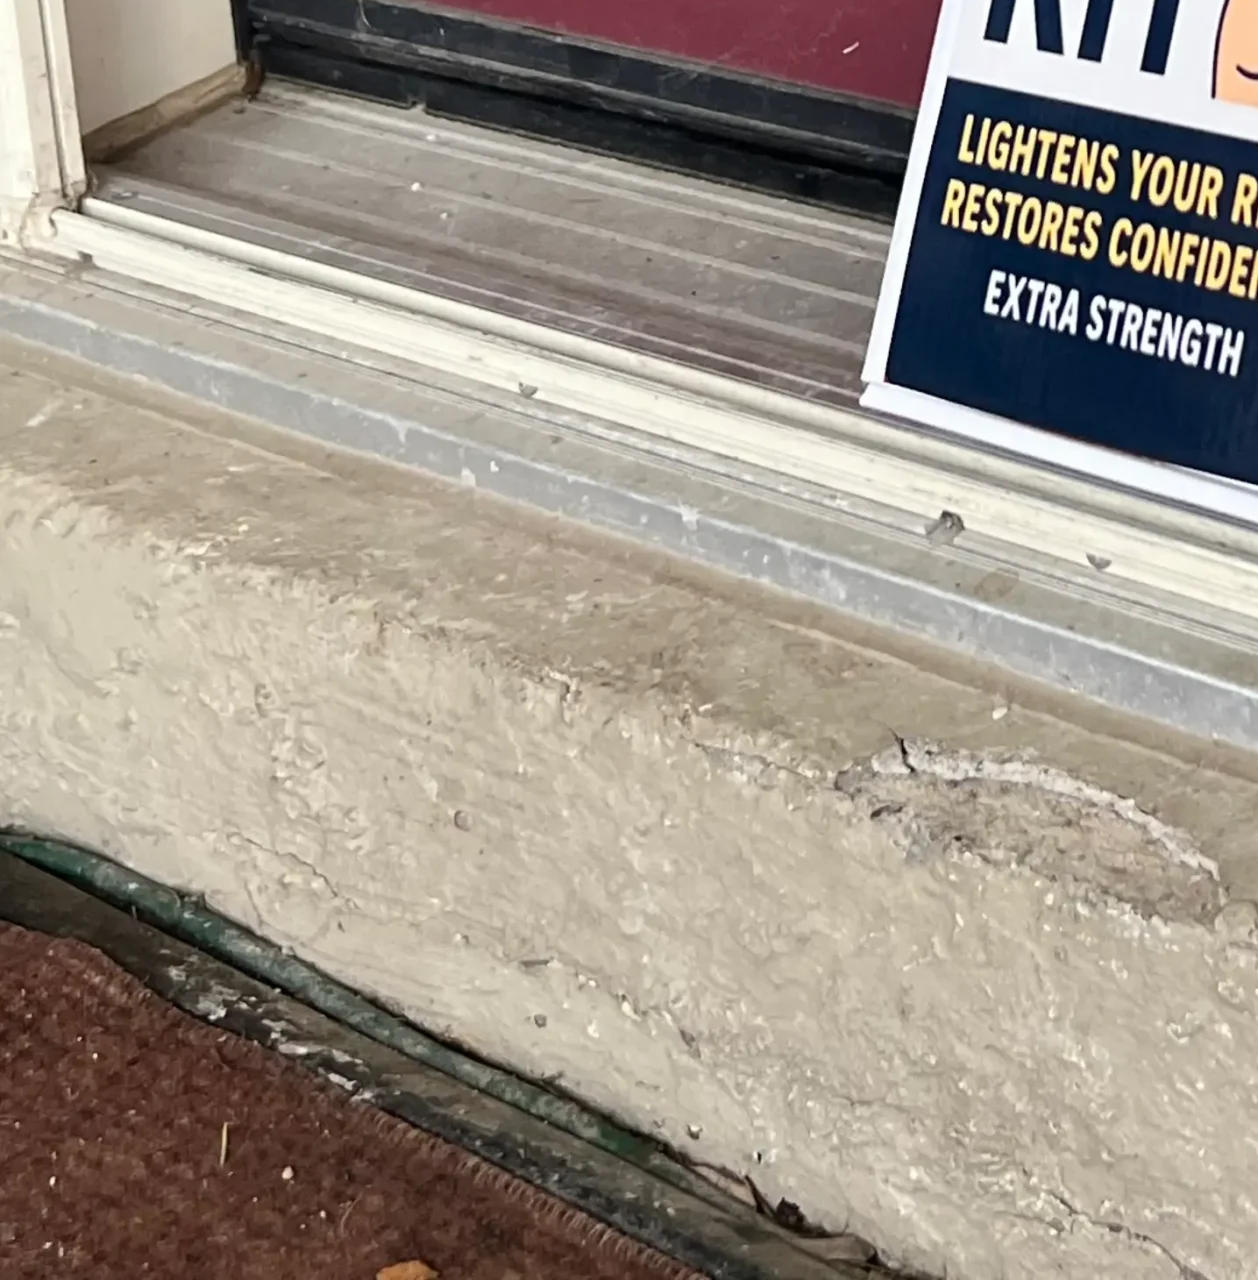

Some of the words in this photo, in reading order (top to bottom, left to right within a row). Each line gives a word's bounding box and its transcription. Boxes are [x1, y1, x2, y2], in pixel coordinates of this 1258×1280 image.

[959, 115, 1119, 193] LIGHTENS
[1131, 150, 1223, 218] YOUR
[941, 179, 1102, 259] RESTORES
[984, 270, 1079, 334] EXTRA
[1086, 295, 1244, 376] STRENGTH
